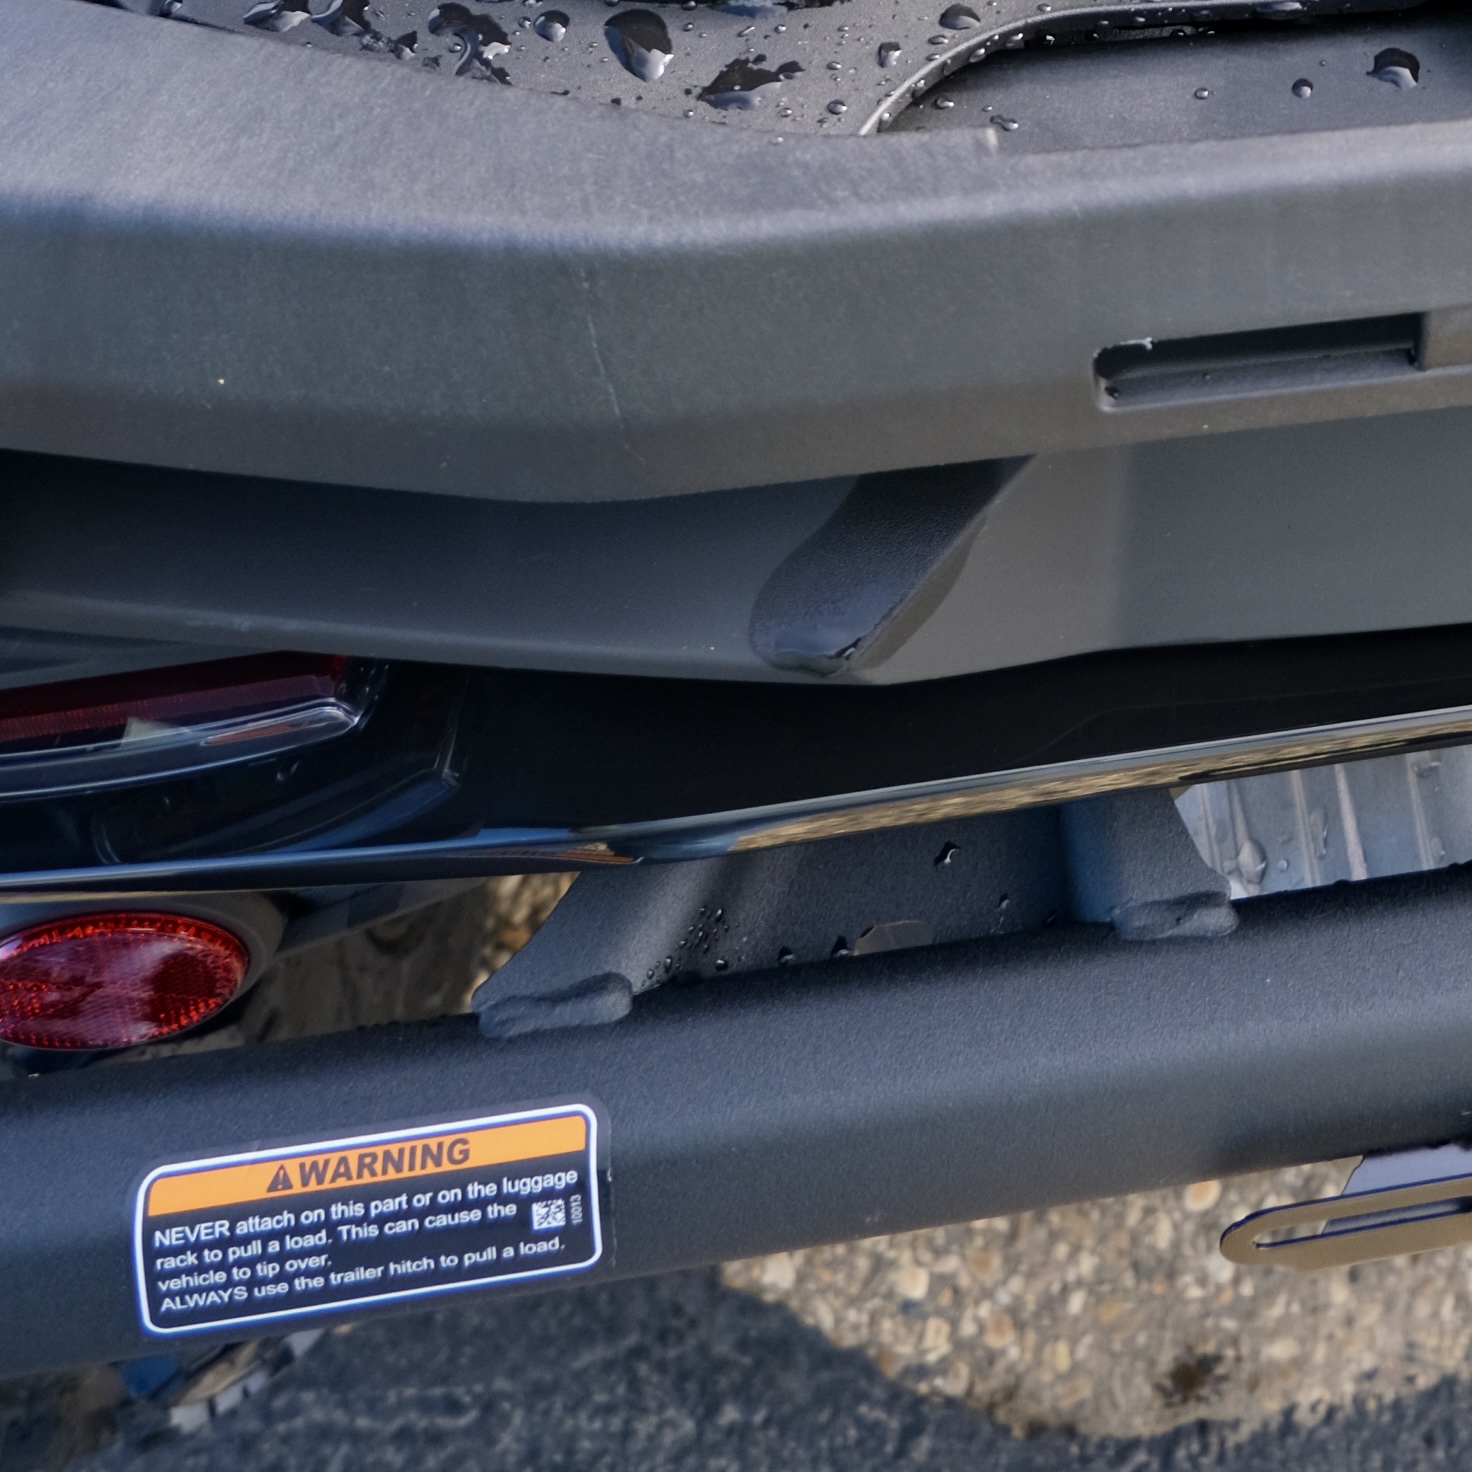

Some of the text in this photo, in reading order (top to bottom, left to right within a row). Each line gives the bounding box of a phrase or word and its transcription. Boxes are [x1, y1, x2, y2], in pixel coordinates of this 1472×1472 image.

[299, 1137, 471, 1188] WARNING
[154, 1170, 578, 1247] NEVER attach on this part or on the luggage
[156, 1203, 517, 1270] rack to pull a load. This can cause the
[158, 1254, 332, 1291] vehicle to tip over.
[160, 1237, 566, 1312] ALWAYS use the trailer hitch to pull a load.
